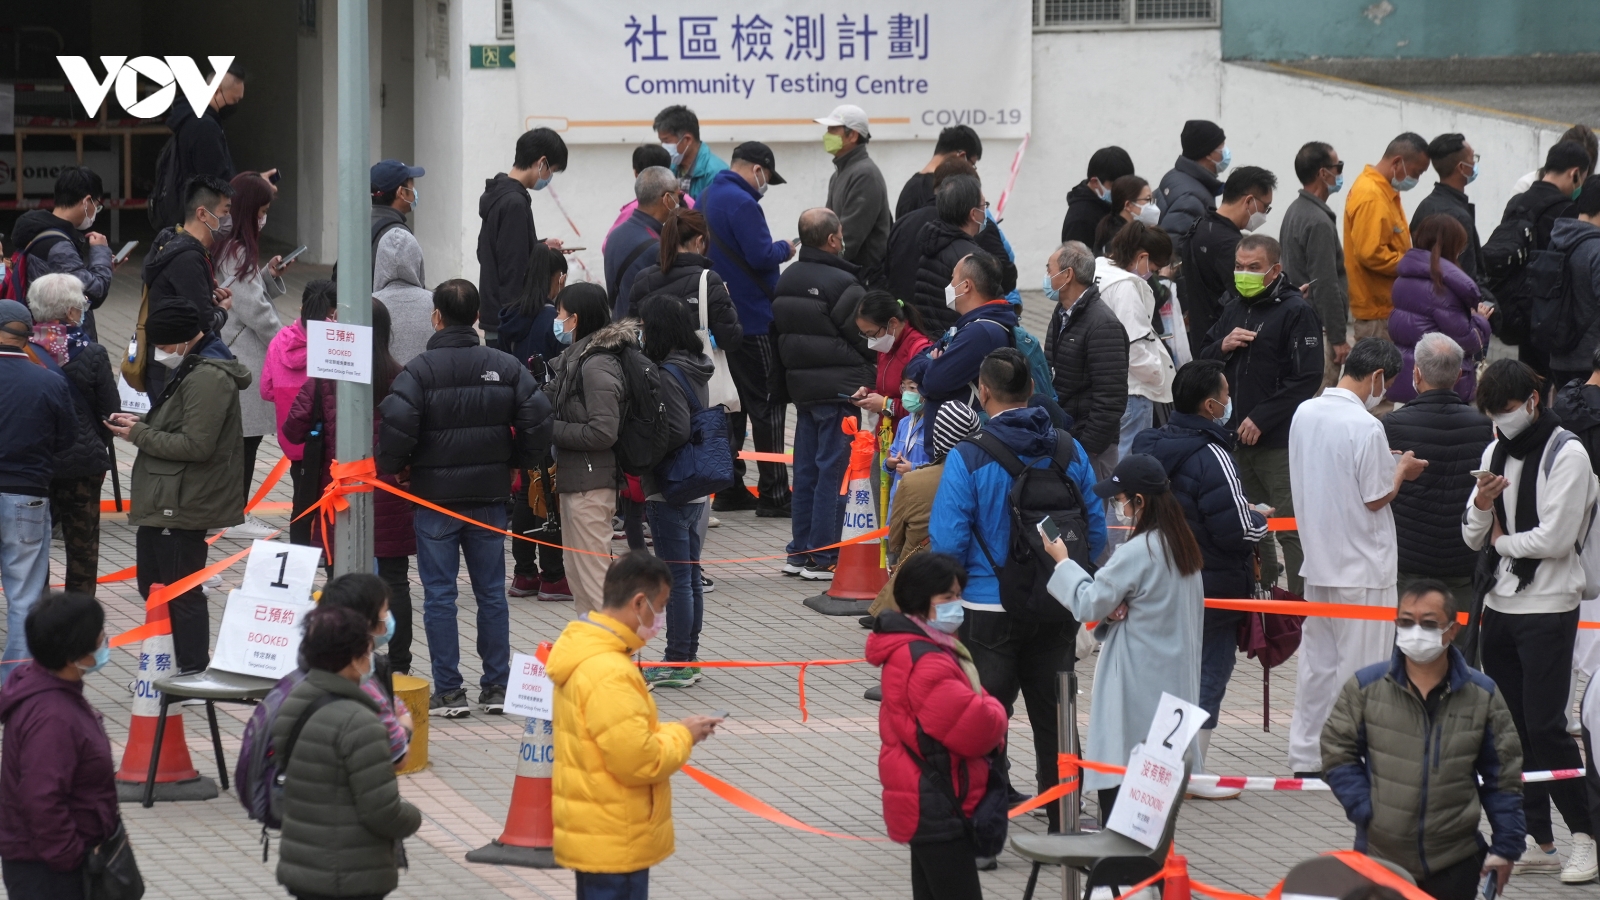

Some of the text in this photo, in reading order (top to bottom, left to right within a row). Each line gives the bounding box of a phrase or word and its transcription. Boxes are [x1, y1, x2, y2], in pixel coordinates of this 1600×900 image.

[624, 12, 929, 63] 社區檢測計劃
[625, 72, 929, 99] Community Testing Centre
[921, 109, 1021, 126] COVID-19
[326, 328, 354, 343] 已預約
[328, 348, 352, 357] BOOKED
[270, 551, 289, 589] 1
[254, 605, 295, 625] 已預約
[247, 631, 289, 648] BOOKED
[139, 652, 171, 671] 警察
[522, 662, 547, 678] 已預約
[521, 683, 542, 693] BOOKED
[1163, 709, 1184, 750] 2
[1129, 788, 1165, 812] NO BOOKING
